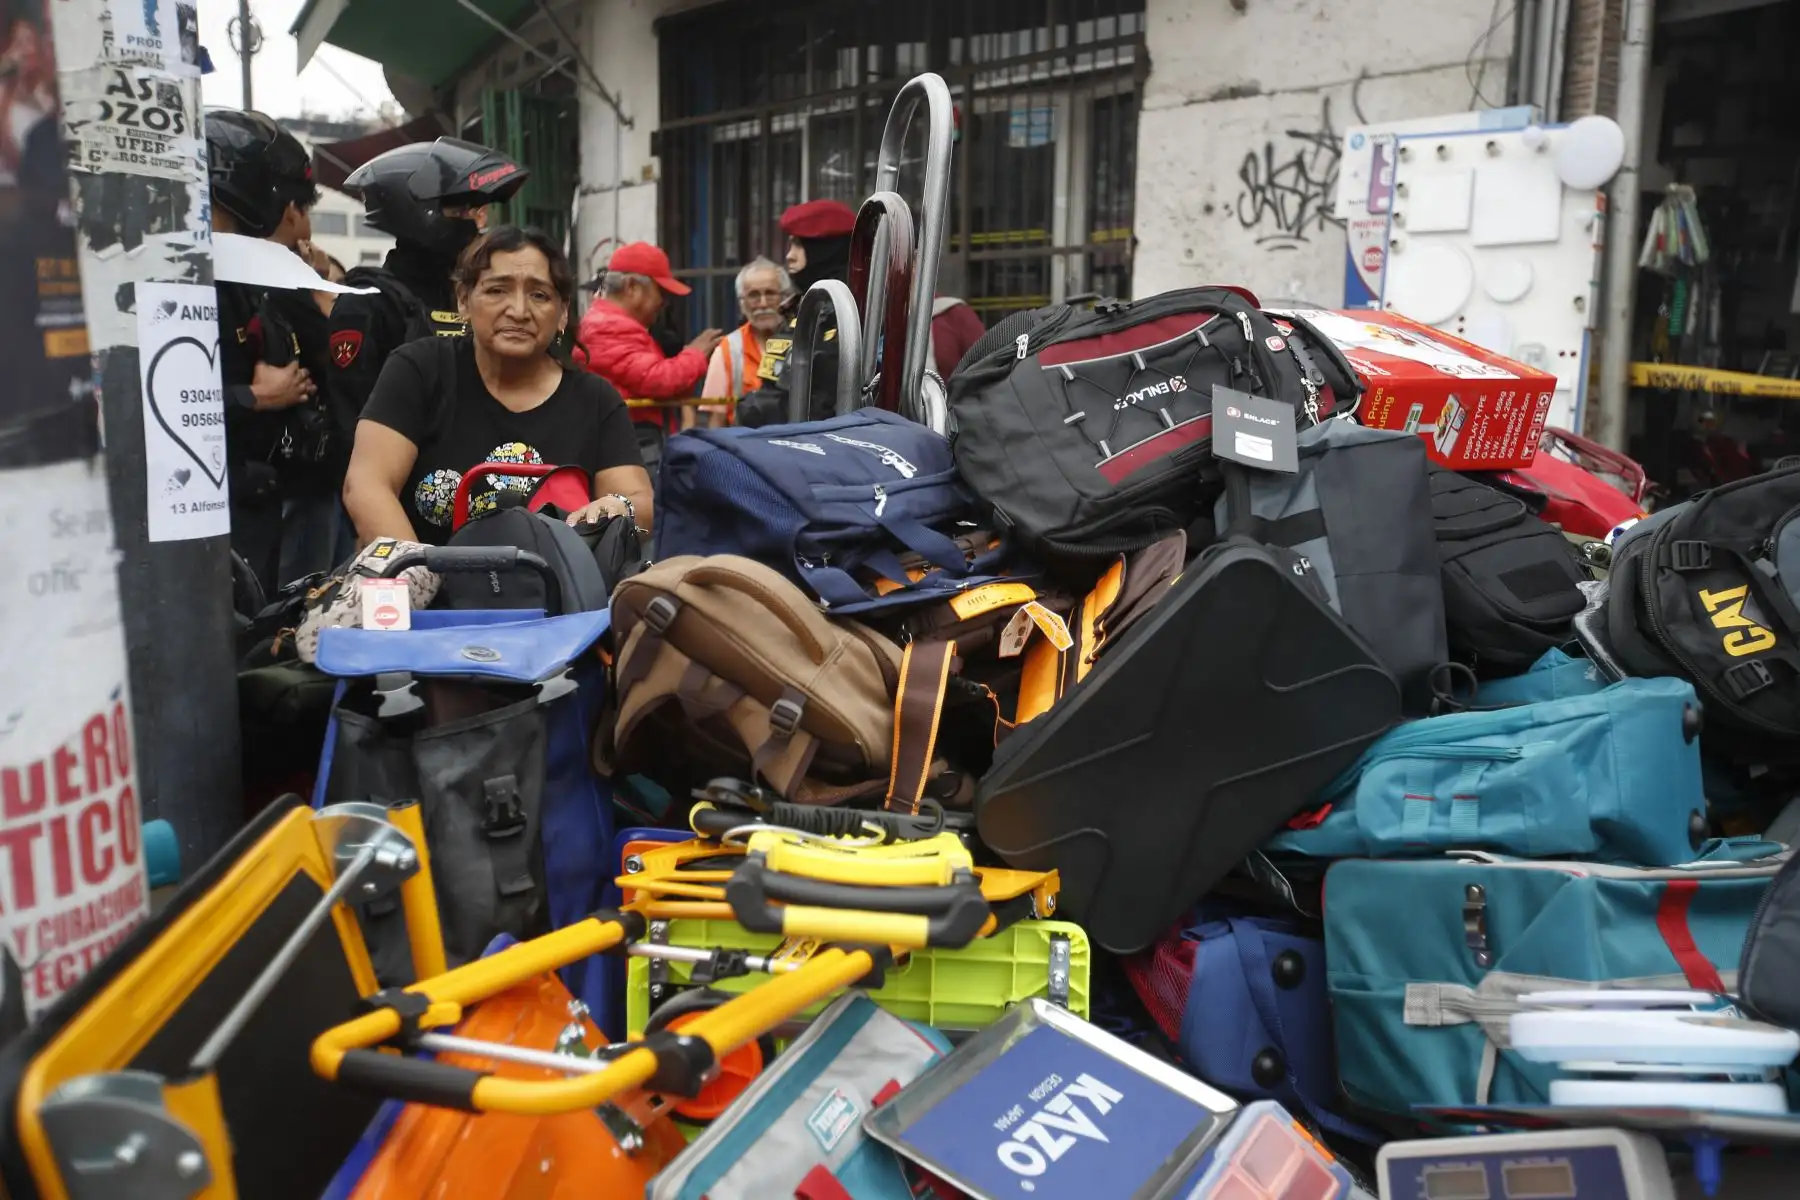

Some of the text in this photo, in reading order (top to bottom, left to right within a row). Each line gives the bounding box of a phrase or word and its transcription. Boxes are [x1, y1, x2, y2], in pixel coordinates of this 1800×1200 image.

[1243, 413, 1278, 426] ENLACE
[1367, 387, 1384, 421] Price
[1379, 396, 1395, 430] uting
[1463, 394, 1487, 459] DISPLAY TYPE
[1472, 414, 1490, 459] CAPACITY
[170, 502, 187, 515] 13
[1698, 584, 1777, 657] CAT
[0, 783, 138, 912] TICO
[997, 1072, 1124, 1176] KAZO
